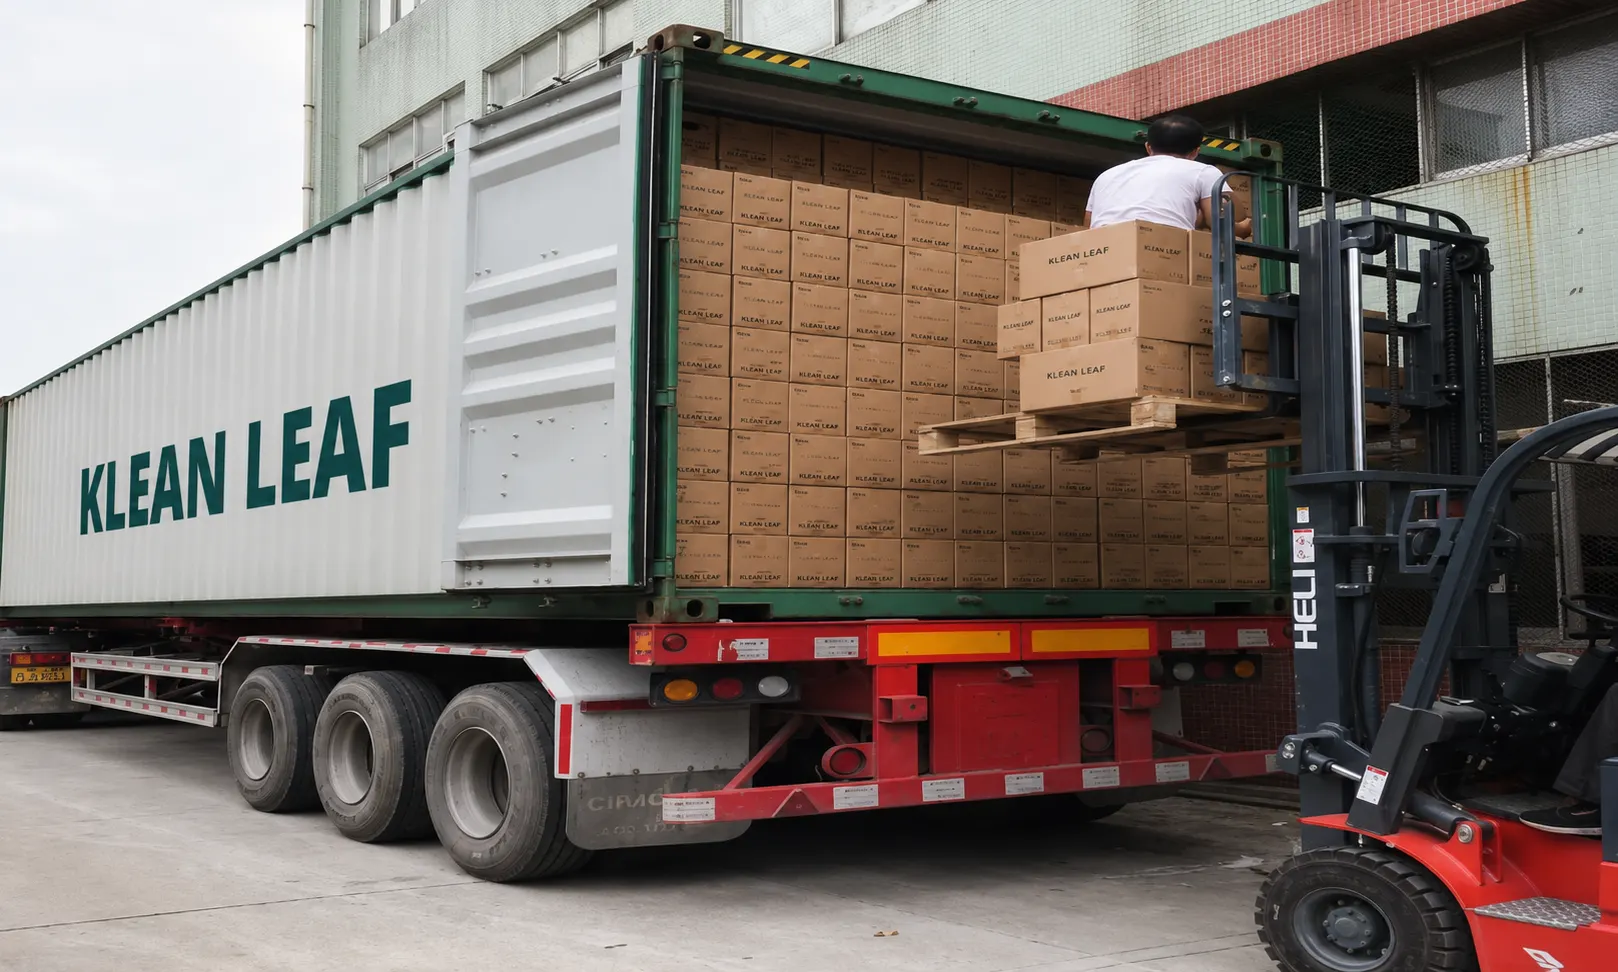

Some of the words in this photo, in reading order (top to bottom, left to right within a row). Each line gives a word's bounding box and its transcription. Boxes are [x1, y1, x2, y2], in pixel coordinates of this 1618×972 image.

[800, 220, 822, 228] KLEAN
[858, 229, 880, 237] KLEAN
[912, 237, 932, 245] KLEAN
[963, 244, 983, 252] KLEAN
[1144, 245, 1164, 253] KLEAN
[1049, 252, 1080, 265] KLEAN
[1084, 247, 1109, 258] LEAF
[857, 278, 879, 286] KLEAN
[1096, 306, 1115, 314] KLEAN
[1116, 303, 1130, 311] LEAF
[741, 316, 764, 324] KLEAN
[1047, 369, 1078, 380] KLEAN
[1081, 365, 1106, 375] LEAF
[80, 430, 226, 535] KLEAN
[246, 379, 411, 509] LEAF
[1292, 569, 1318, 649] HELI
